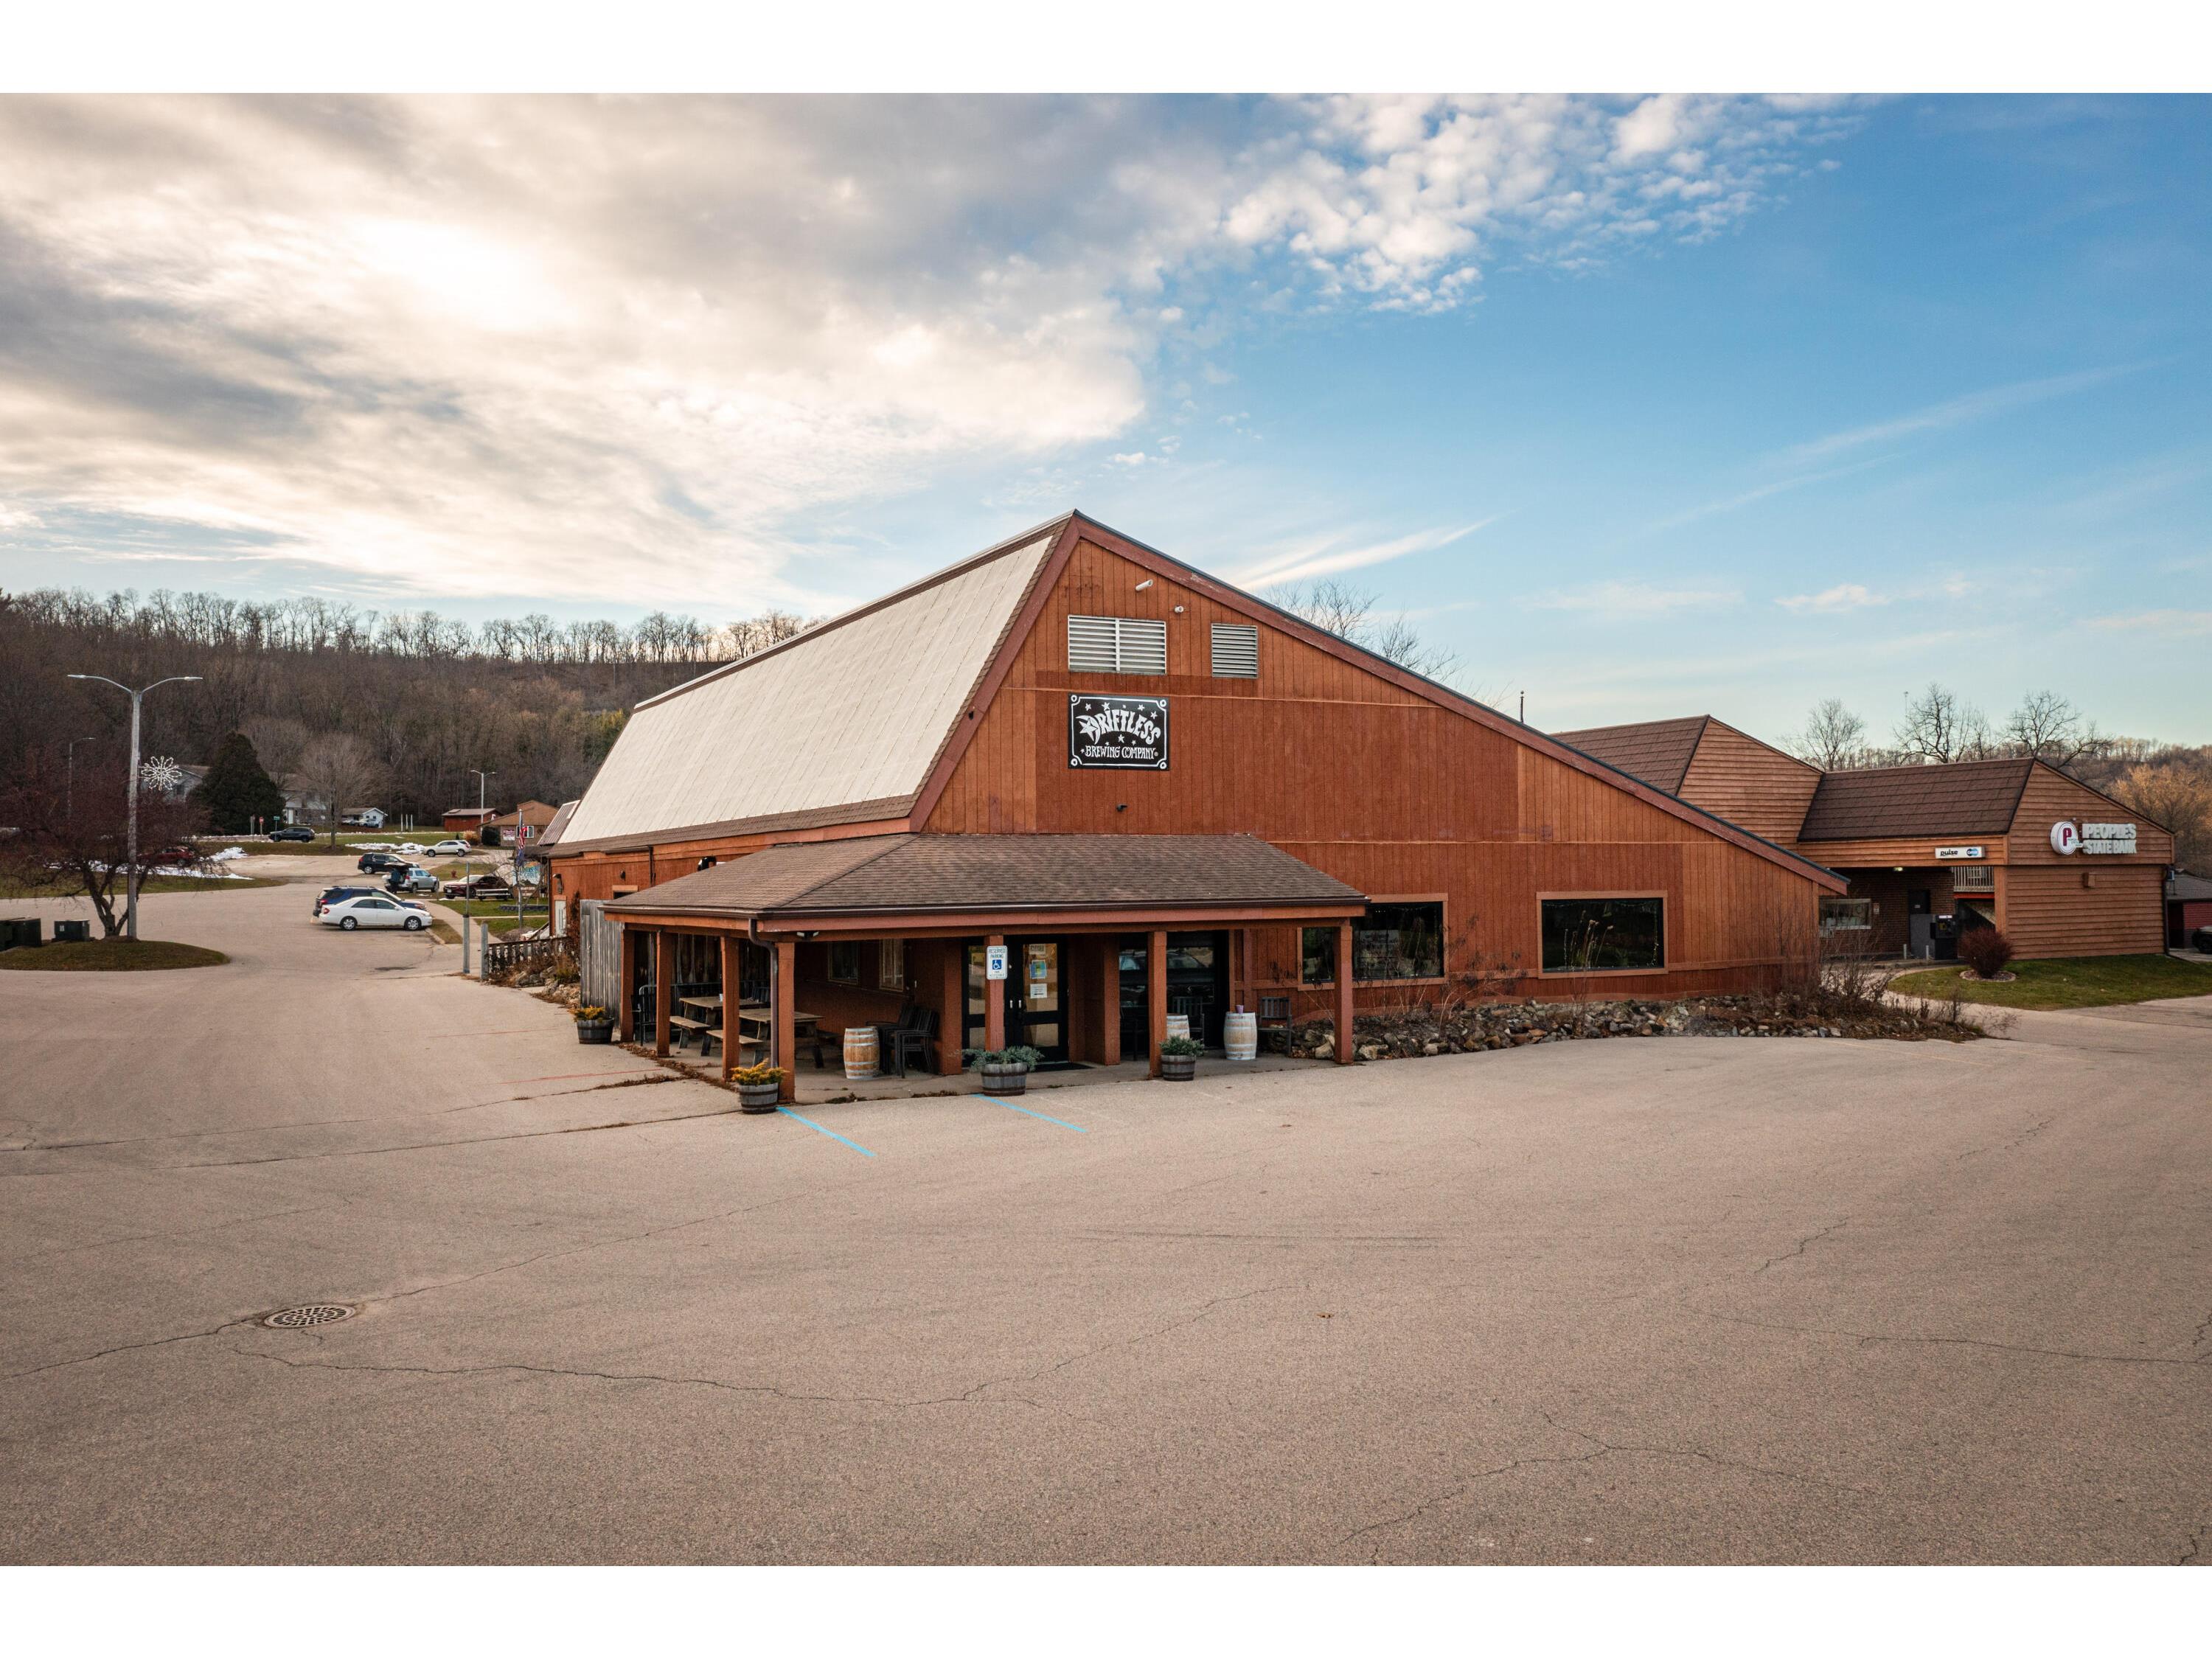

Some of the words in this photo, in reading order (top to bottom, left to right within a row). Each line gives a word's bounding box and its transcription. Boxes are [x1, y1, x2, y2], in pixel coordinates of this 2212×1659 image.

[1085, 745, 1121, 758] BREWING
[1121, 746, 1156, 759] COMPANY
[2062, 827, 2072, 846] P
[2084, 824, 2137, 838] PEOPLES
[1940, 849, 1958, 857] pulse
[2085, 840, 2112, 854] STATE
[2112, 840, 2137, 854] BANK
